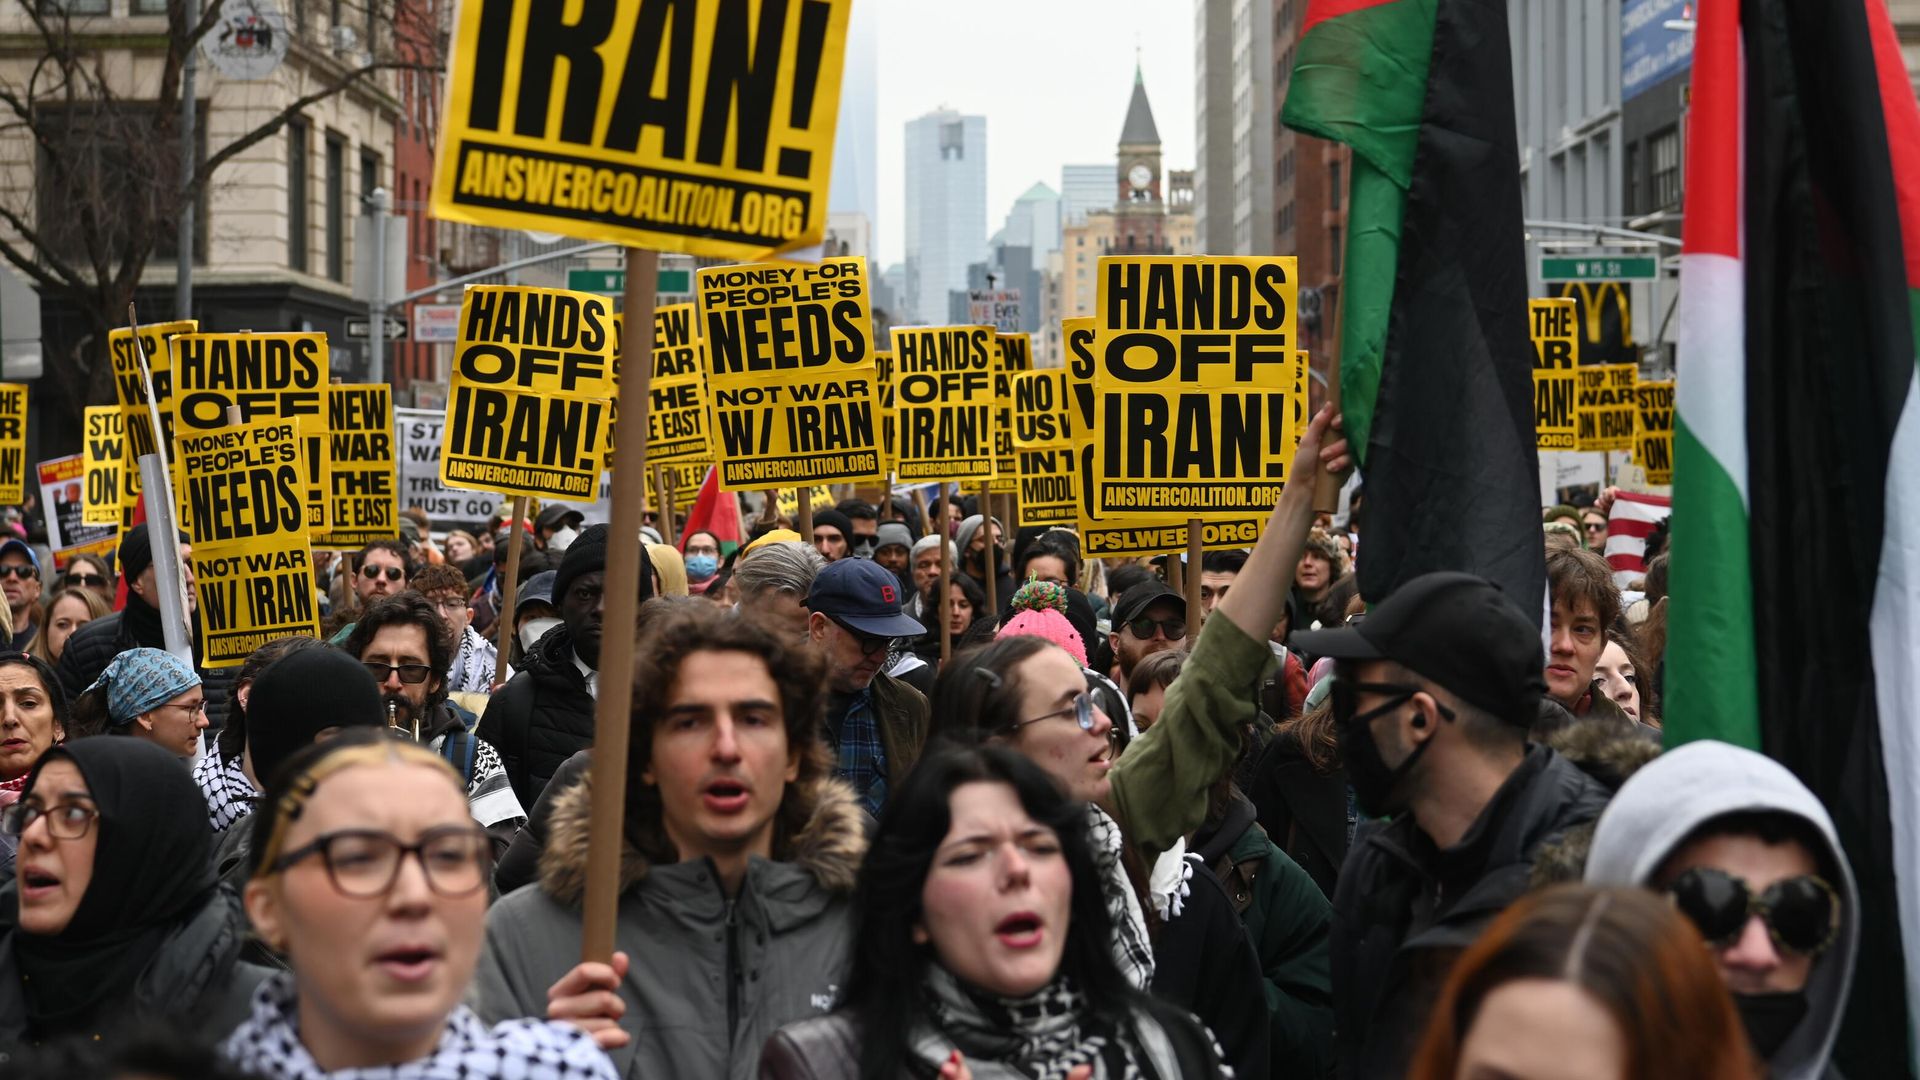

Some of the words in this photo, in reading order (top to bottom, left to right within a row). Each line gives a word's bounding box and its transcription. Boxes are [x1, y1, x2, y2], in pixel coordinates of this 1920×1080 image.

[468, 0, 831, 179] IRAN!
[460, 149, 805, 241] ANSWERCOALITION.ORG
[605, 275, 617, 289] W
[703, 268, 796, 289] MONEY
[803, 262, 860, 281] FOR
[1575, 262, 1586, 276] W
[705, 279, 861, 309] PEOPLE'S
[1107, 263, 1287, 331] HANDS
[466, 291, 606, 352] HANDS
[708, 300, 866, 375] NEEDS
[1532, 307, 1572, 338] THE
[113, 335, 157, 371] STOP
[181, 339, 319, 390] HANDS
[460, 344, 605, 391] OFF
[898, 330, 989, 373] HANDS
[1105, 333, 1285, 383] OFF
[716, 386, 784, 407] NOT
[788, 379, 869, 401] WAR
[900, 372, 989, 404] OFF
[1016, 374, 1053, 412] NO
[1609, 368, 1633, 387] THE
[180, 391, 320, 430] OFF
[328, 390, 387, 431] NEW
[1578, 388, 1635, 407] WAR
[449, 386, 602, 471] IRAN!
[664, 408, 701, 439] EAST
[718, 407, 774, 457] W/
[786, 400, 875, 453] IRAN
[900, 405, 990, 459] IRAN!
[1017, 414, 1056, 442] US
[1103, 393, 1285, 479] IRAN!
[1599, 410, 1635, 438] IRAN
[182, 432, 247, 456] MONEY
[253, 424, 294, 446] FOR
[1644, 437, 1670, 470] ON
[186, 442, 296, 476] PEOPLE'S
[726, 453, 876, 481] ANSWERCOALITION.ORG
[900, 461, 990, 477] ANSWERCOALITION.ORG
[1020, 450, 1057, 475] IN
[88, 467, 118, 506] ON
[448, 460, 589, 493] ANSWERCOALITION.ORG
[1022, 474, 1077, 504] MIDDL
[189, 465, 302, 544] NEEDS
[353, 498, 392, 527] EAST
[408, 497, 460, 514] MUST
[465, 499, 493, 516] GO
[1105, 486, 1281, 507] ANSWERCOALITION.ORG
[1089, 523, 1258, 551] PSLWEBORG
[197, 556, 242, 580] NOT
[246, 550, 307, 577] WAR
[200, 579, 240, 631] W/
[249, 572, 314, 627] IRAN
[881, 585, 896, 603] B
